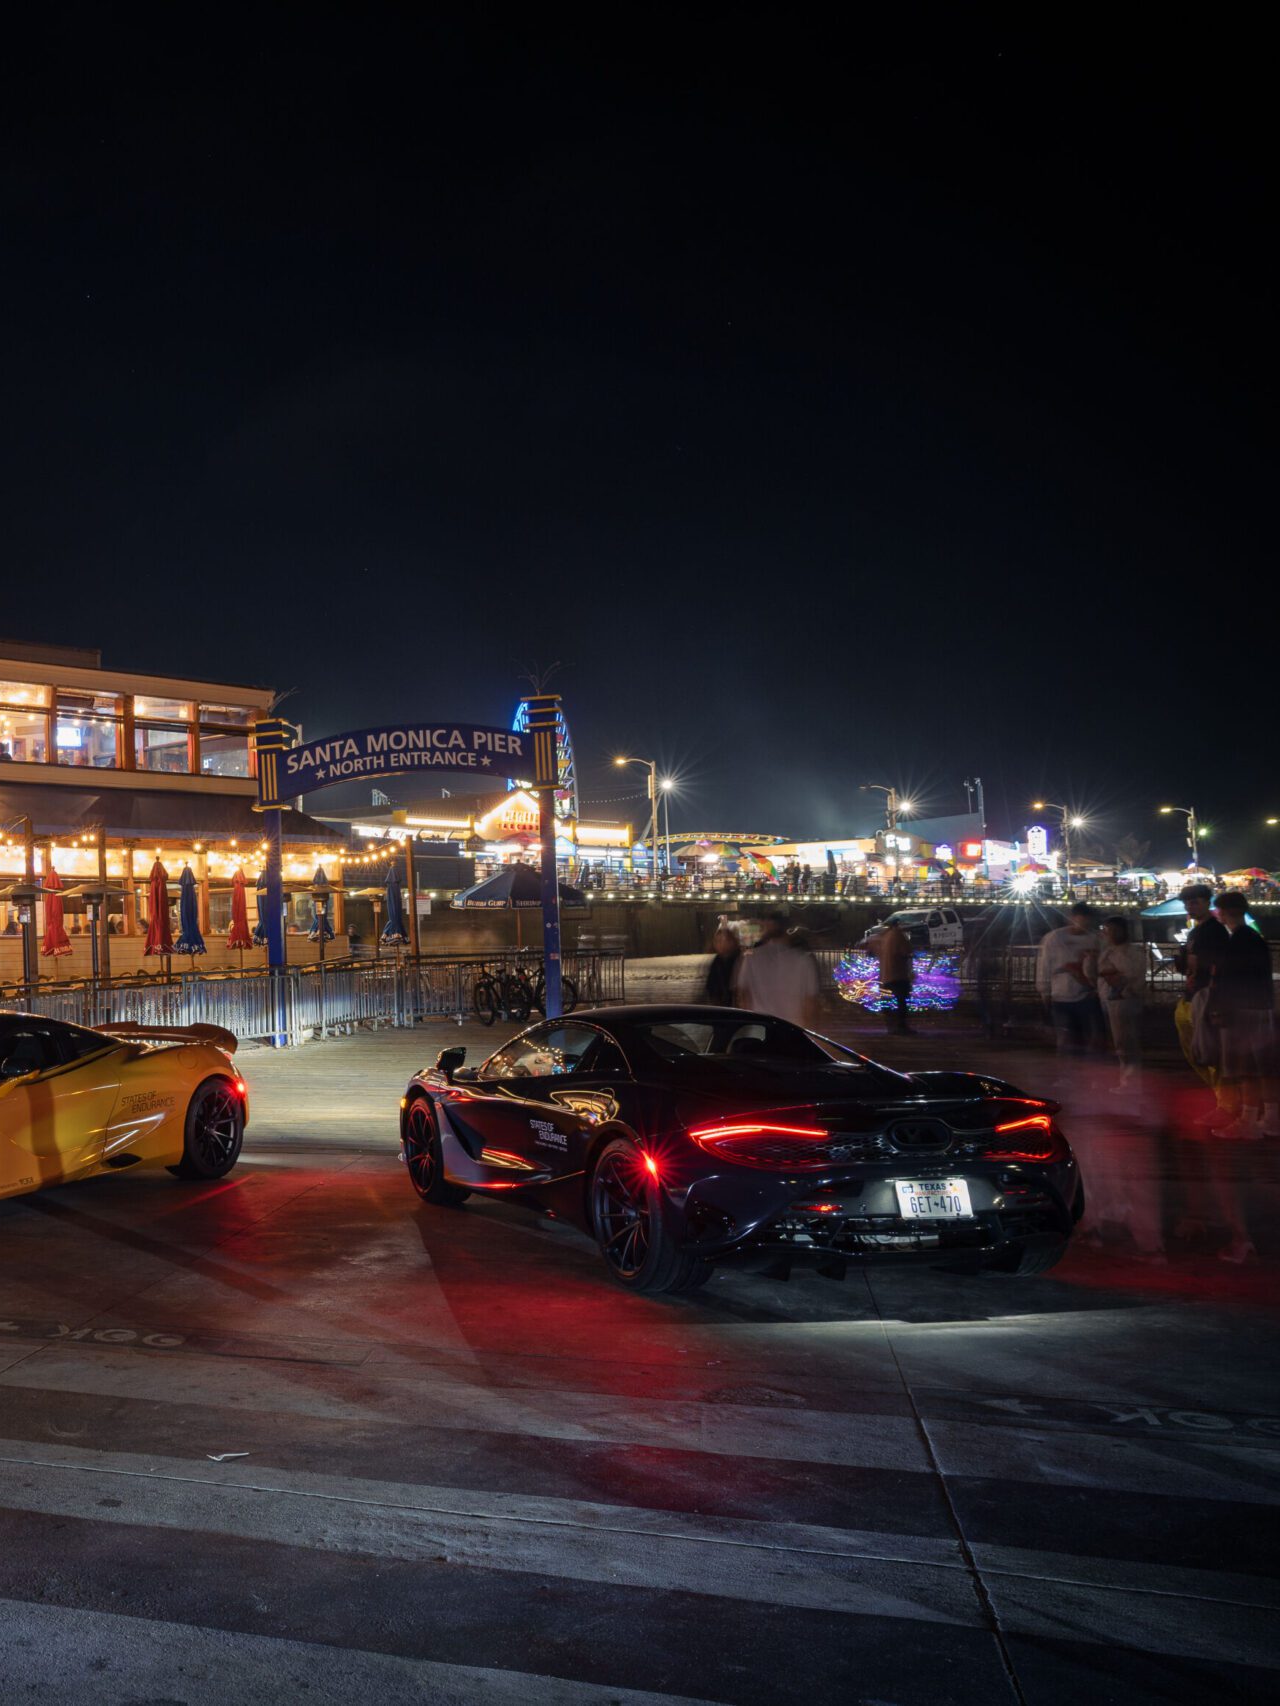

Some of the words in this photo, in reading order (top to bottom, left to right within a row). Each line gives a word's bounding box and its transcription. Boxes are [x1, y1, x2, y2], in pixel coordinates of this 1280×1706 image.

[286, 738, 360, 774] SANTA
[366, 729, 466, 754] MONICA
[472, 730, 523, 756] PIER
[329, 754, 385, 778] NORTH
[390, 751, 477, 768] ENTRANCE
[122, 1094, 147, 1106] STATES
[147, 1091, 156, 1100] OF
[132, 1097, 175, 1113] ENDURANCE
[530, 1119, 548, 1131] STATES
[539, 1131, 567, 1145] ENDURANCE
